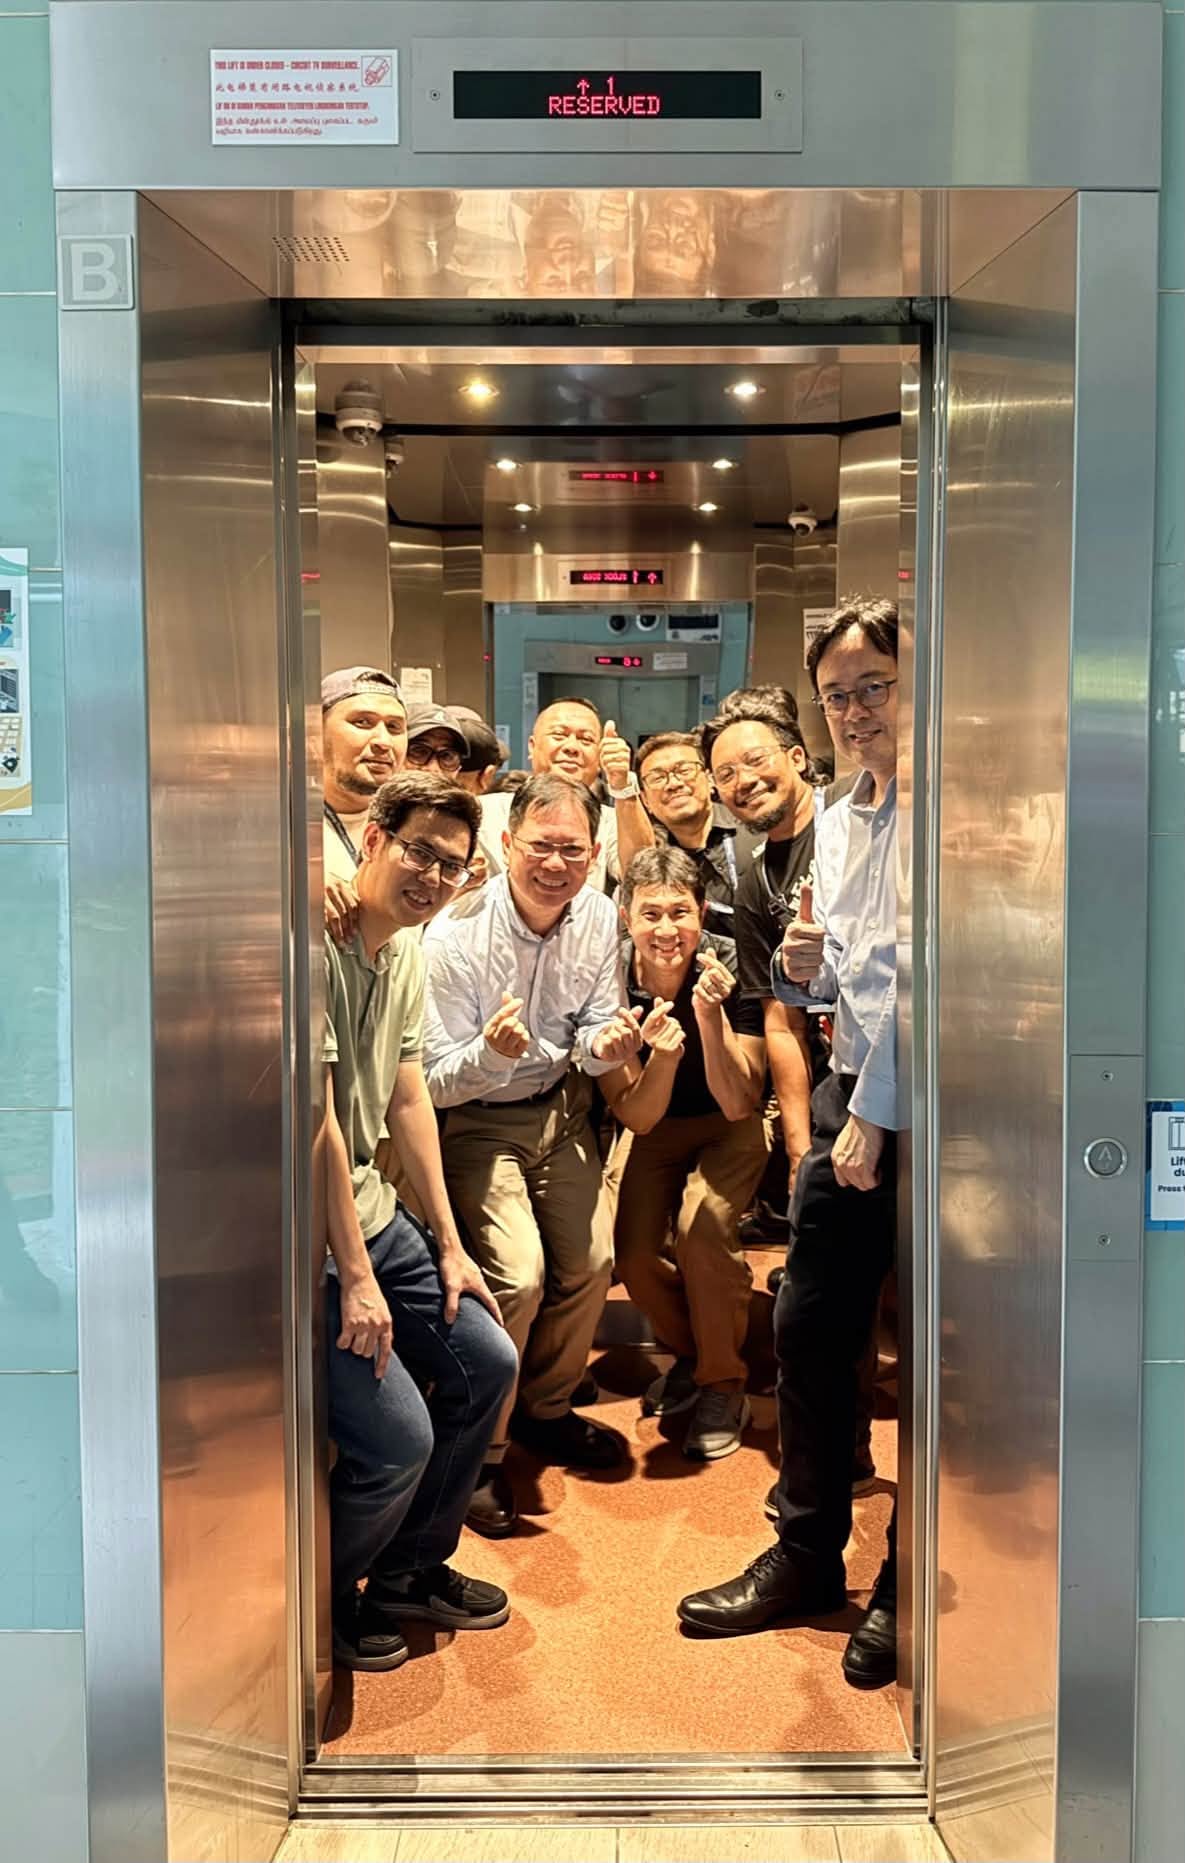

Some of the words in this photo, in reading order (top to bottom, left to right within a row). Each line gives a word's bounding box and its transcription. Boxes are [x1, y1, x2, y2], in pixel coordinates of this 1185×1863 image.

[606, 76, 615, 95] 1
[548, 96, 660, 115] RESERVED
[71, 242, 117, 301] B
[1158, 1184, 1181, 1193] Press
